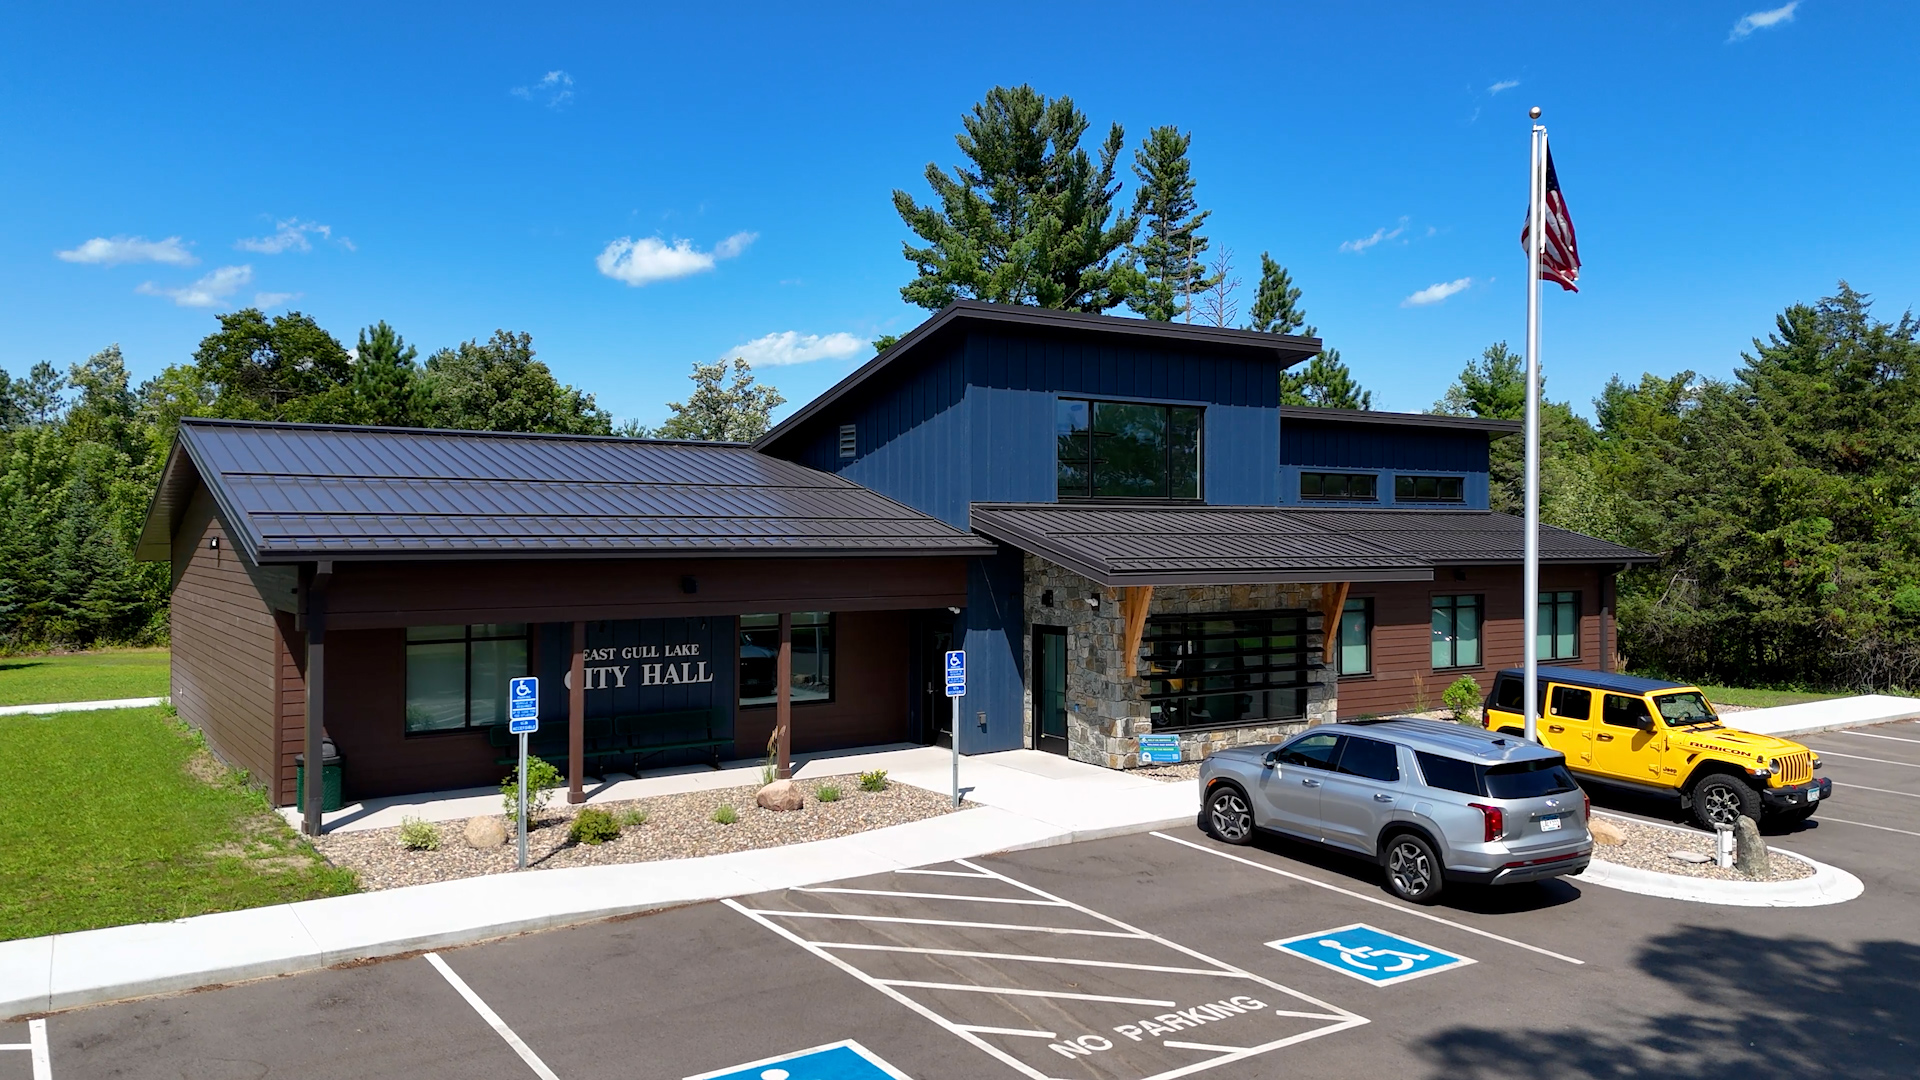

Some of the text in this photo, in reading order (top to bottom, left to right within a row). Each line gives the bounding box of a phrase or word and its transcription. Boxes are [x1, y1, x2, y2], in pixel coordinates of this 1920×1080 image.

[583, 644, 700, 661] EAST GULL LAKE
[641, 661, 713, 686] HALL
[1690, 741, 1752, 757] RUBICON
[1048, 996, 1268, 1060] NO PARKING
